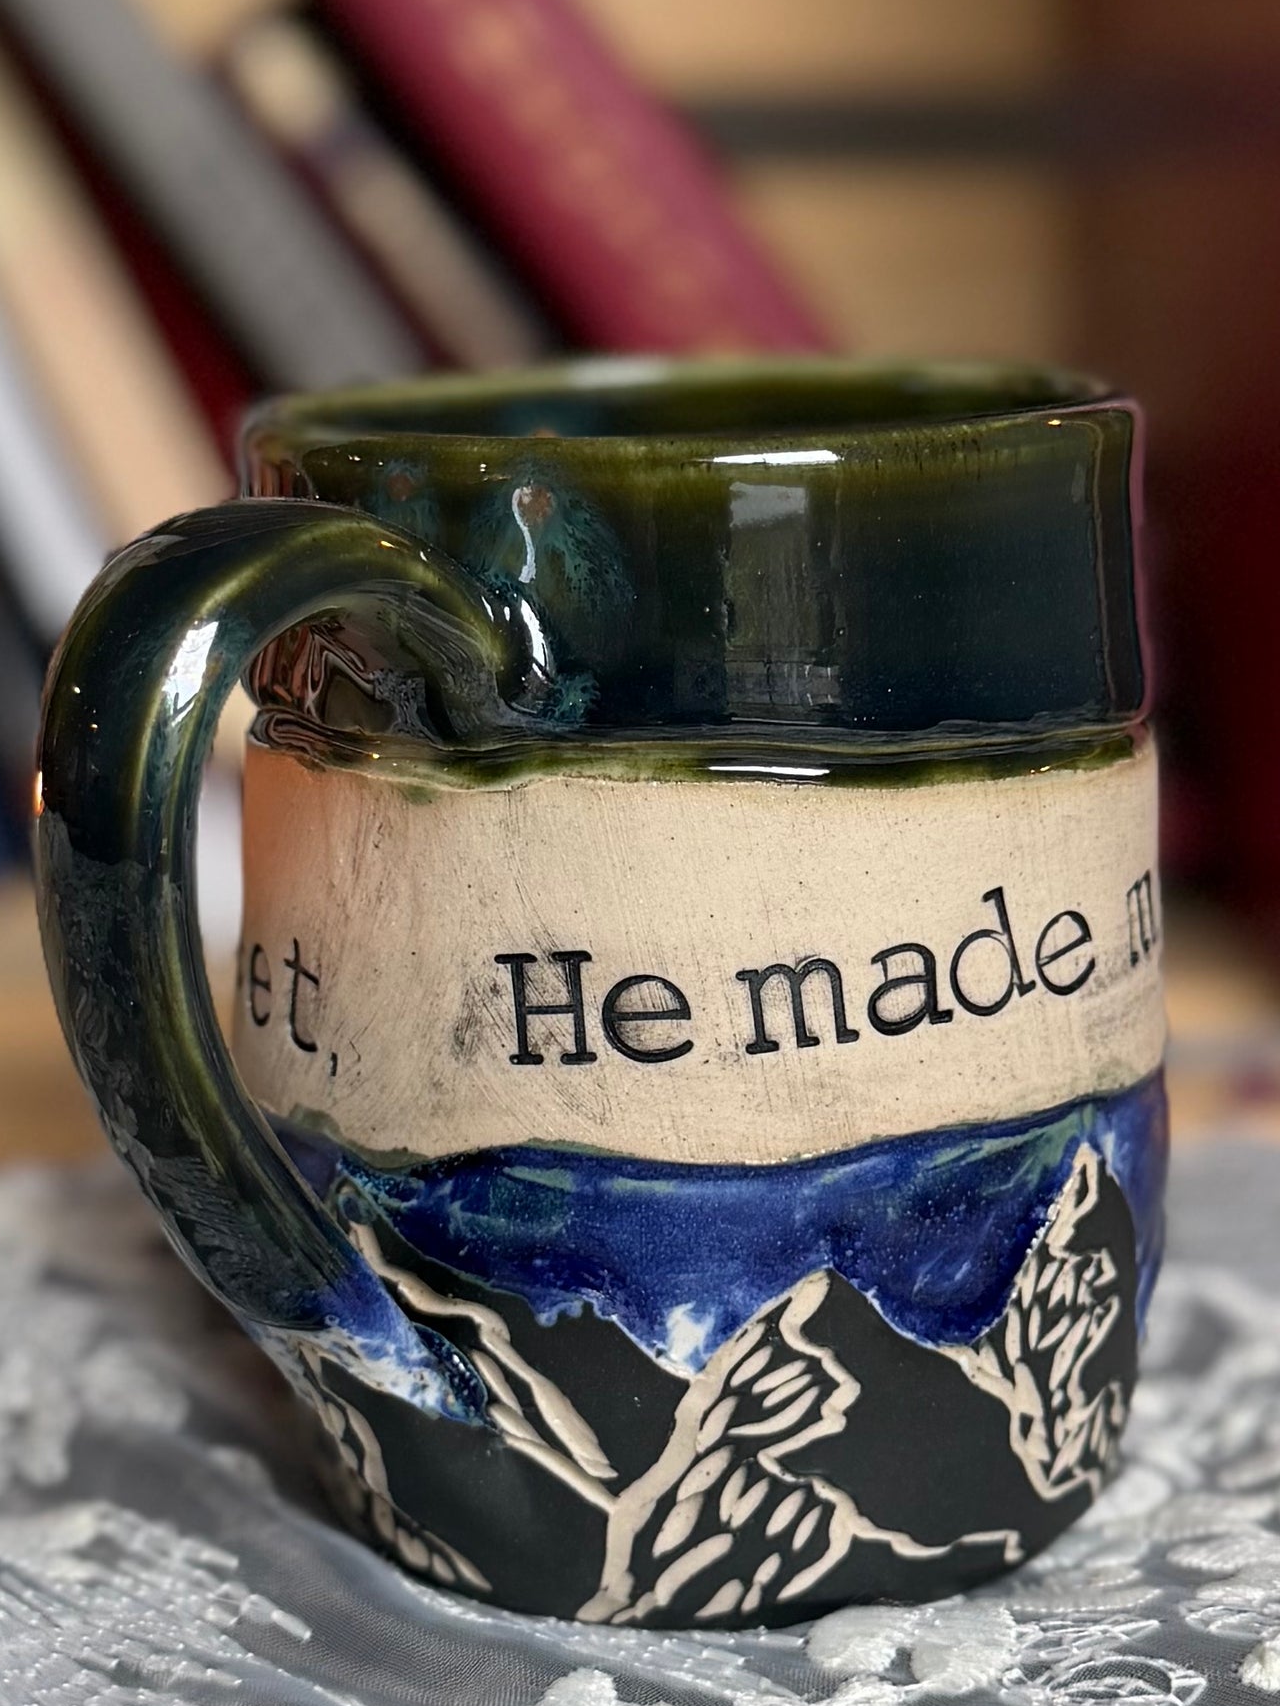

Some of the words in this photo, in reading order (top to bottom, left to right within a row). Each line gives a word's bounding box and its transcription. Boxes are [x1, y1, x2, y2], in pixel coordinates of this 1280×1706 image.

[239, 936, 338, 1077] et,
[493, 949, 695, 1066] He
[735, 885, 1097, 1056] made
